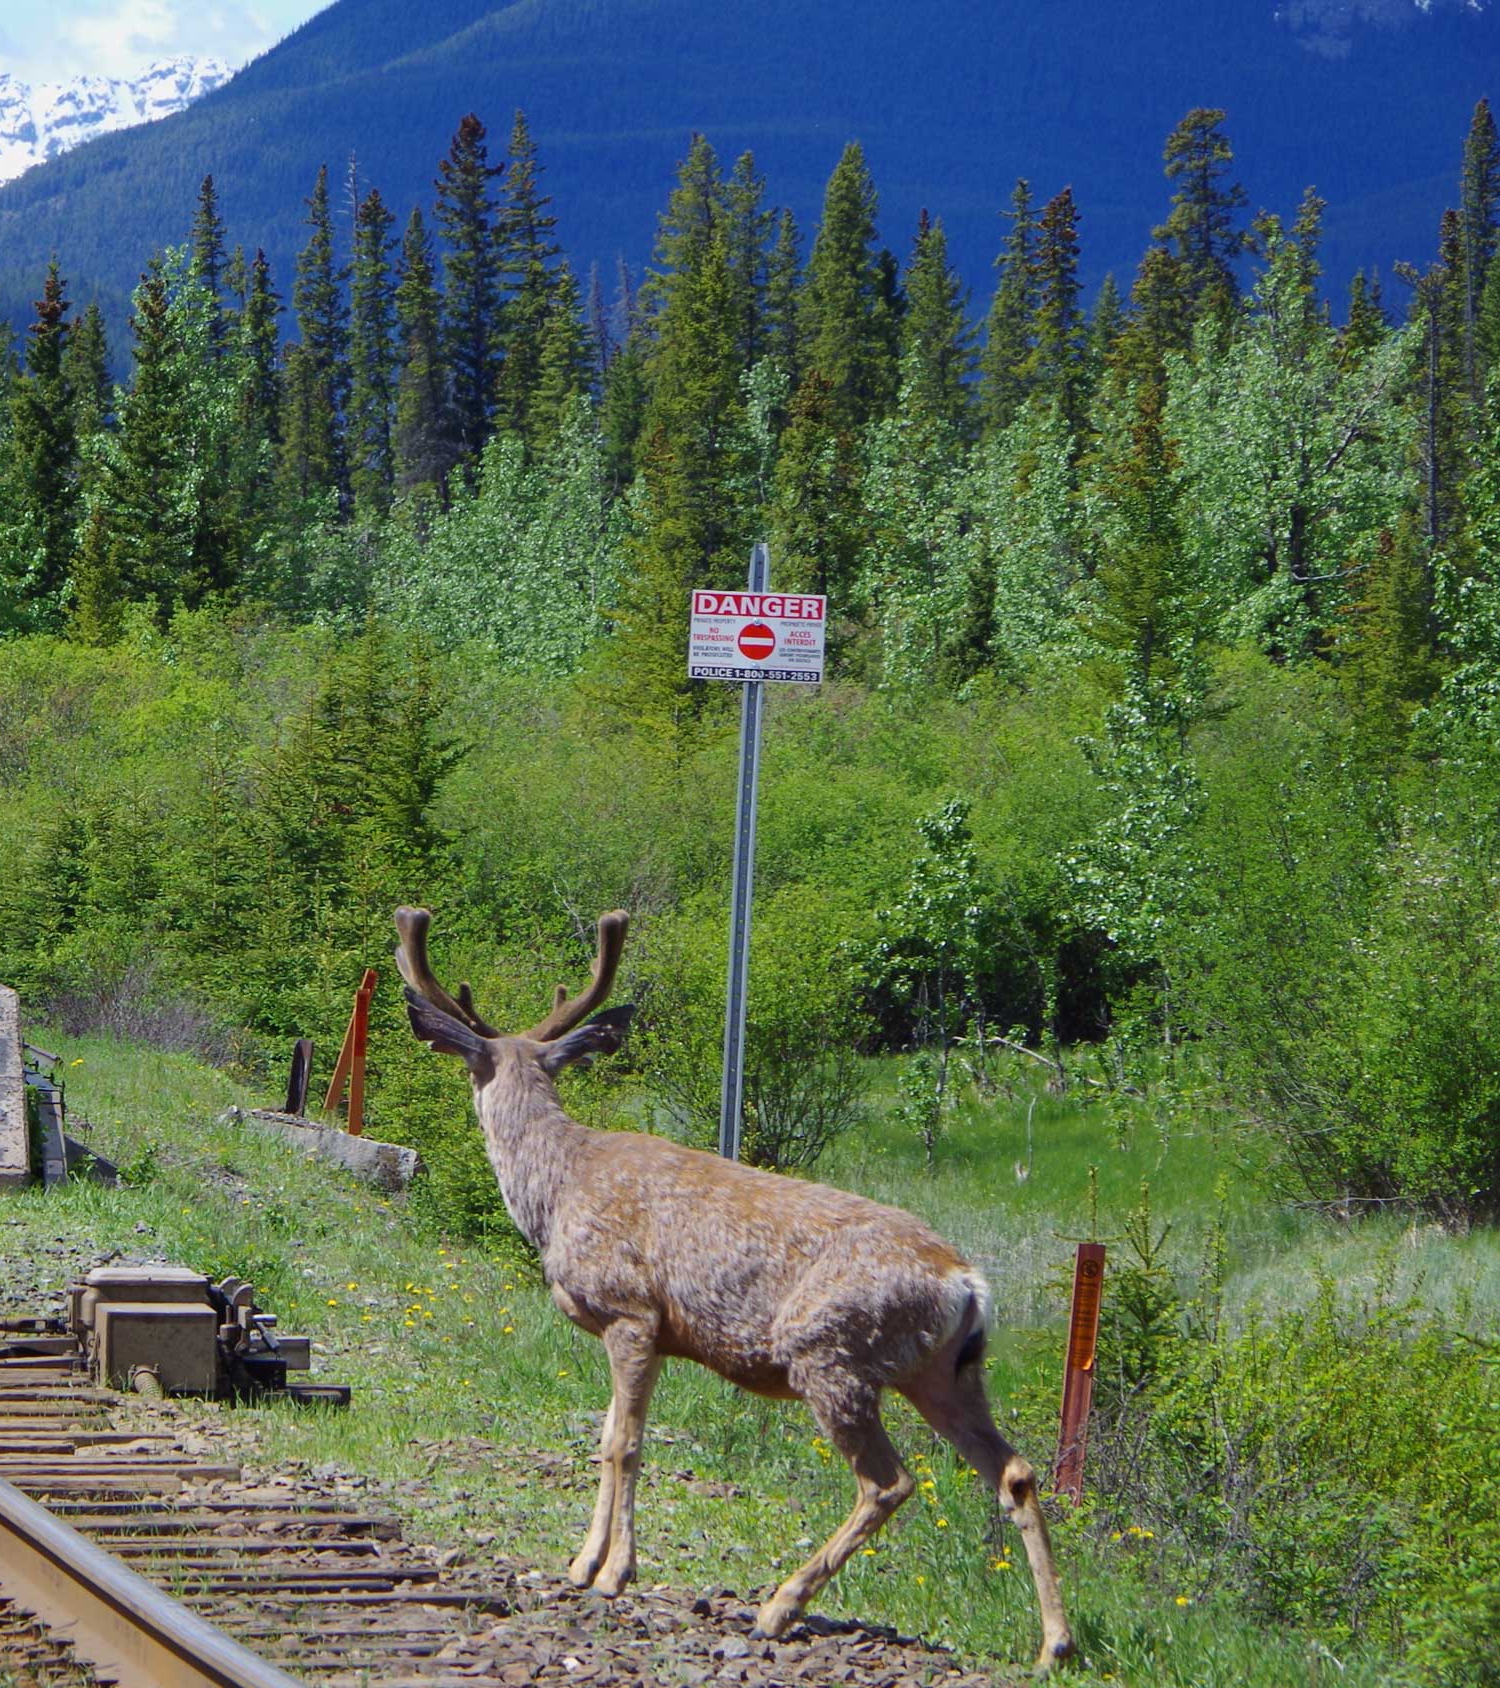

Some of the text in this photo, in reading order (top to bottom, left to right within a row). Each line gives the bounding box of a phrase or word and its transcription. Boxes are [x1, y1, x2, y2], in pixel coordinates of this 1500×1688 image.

[698, 595, 819, 618] DANGER
[693, 633, 734, 642] TRESPASSING
[784, 638, 816, 646] INTERDIT
[694, 668, 817, 680] POLICE 1-800-551-2553
